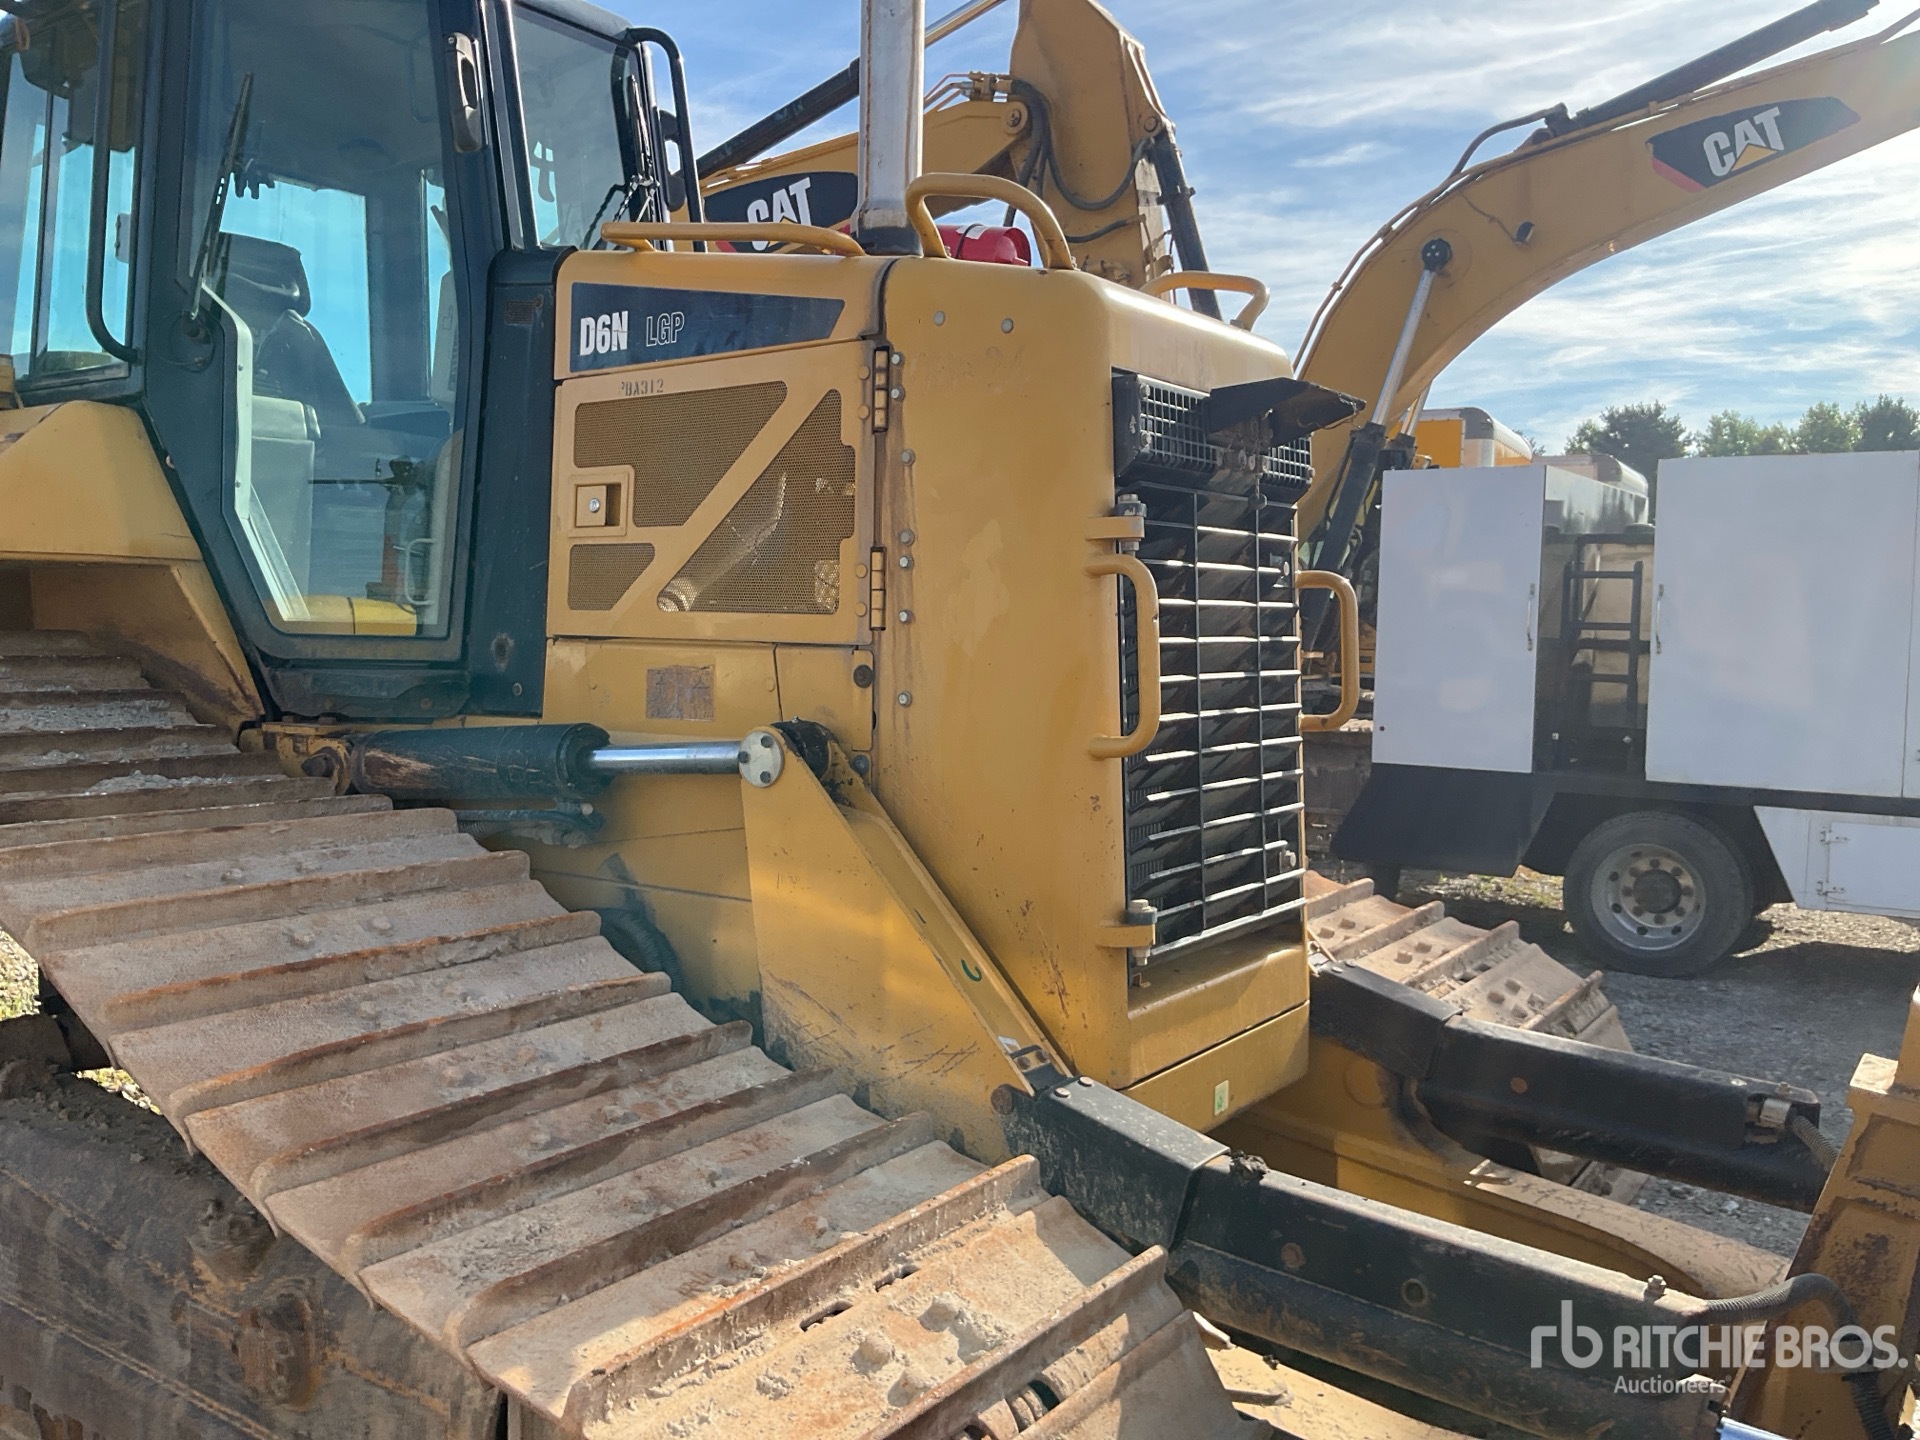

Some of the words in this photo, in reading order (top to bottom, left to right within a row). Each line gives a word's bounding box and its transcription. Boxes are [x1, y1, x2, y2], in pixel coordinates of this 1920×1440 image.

[1703, 106, 1784, 177] CAT
[747, 177, 812, 251] CAT
[580, 310, 629, 356] D6N
[646, 311, 685, 347] LGP
